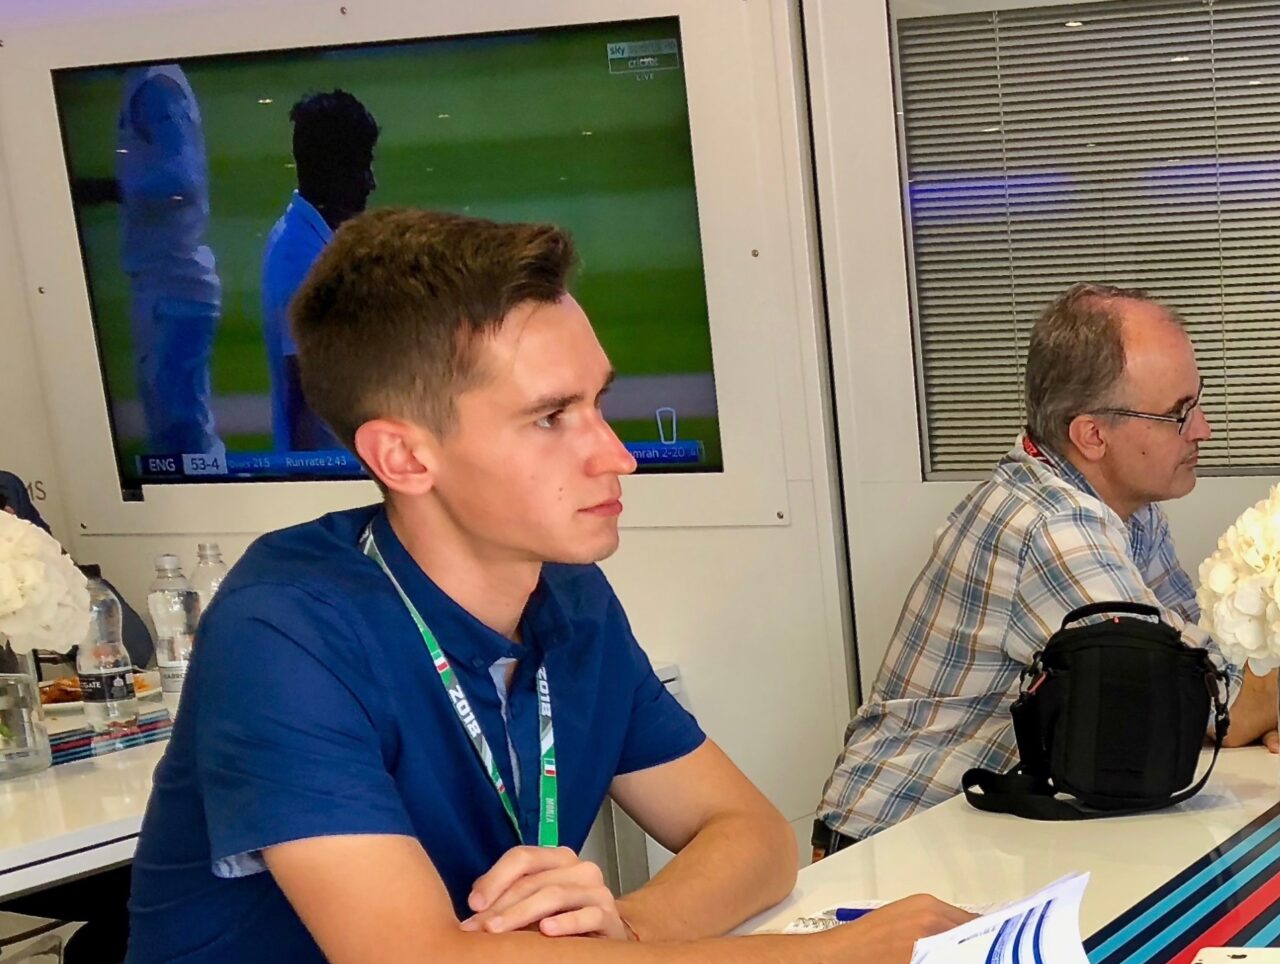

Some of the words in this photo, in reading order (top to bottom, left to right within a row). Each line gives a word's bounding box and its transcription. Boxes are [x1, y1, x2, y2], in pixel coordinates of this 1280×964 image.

[609, 45, 625, 56] sky
[149, 458, 176, 472] ENG
[191, 457, 219, 471] 53-4
[286, 457, 304, 467] Run
[538, 666, 552, 718] 2018
[449, 684, 482, 738] 2018
